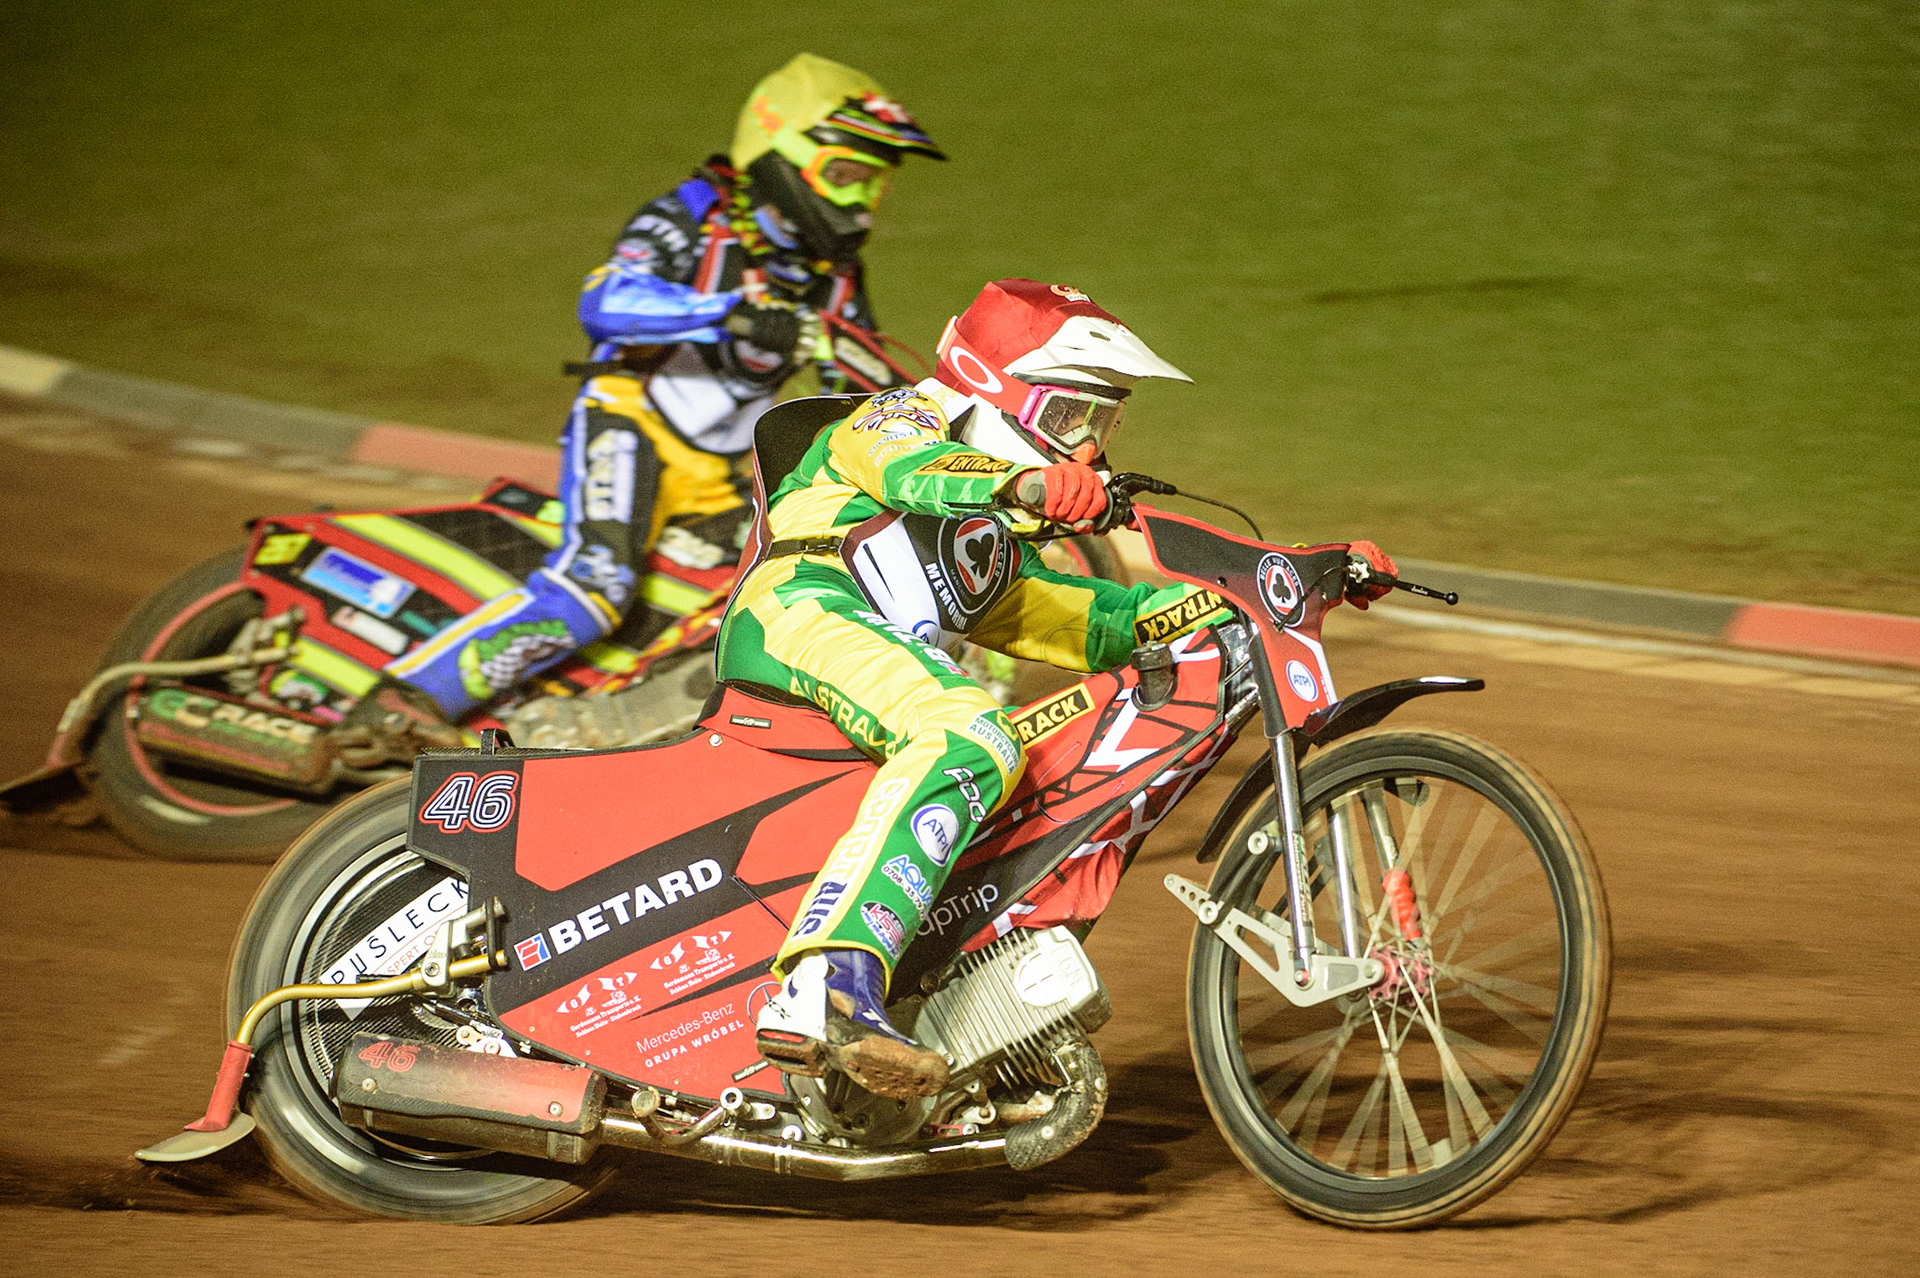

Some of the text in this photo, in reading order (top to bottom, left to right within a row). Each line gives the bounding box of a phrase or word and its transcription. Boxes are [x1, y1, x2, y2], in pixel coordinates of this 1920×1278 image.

[1293, 674, 1312, 689] ATPI
[1016, 695, 1082, 742] RACK
[969, 723, 1016, 775] AUSTRALIA
[419, 771, 519, 834] 46
[922, 818, 950, 852] ATPI
[548, 858, 723, 955] BETARD
[636, 1003, 735, 1054] Mercedes-Benz
[645, 1018, 745, 1068] GRUPA WRÓBEL
[358, 1041, 421, 1073] 46
